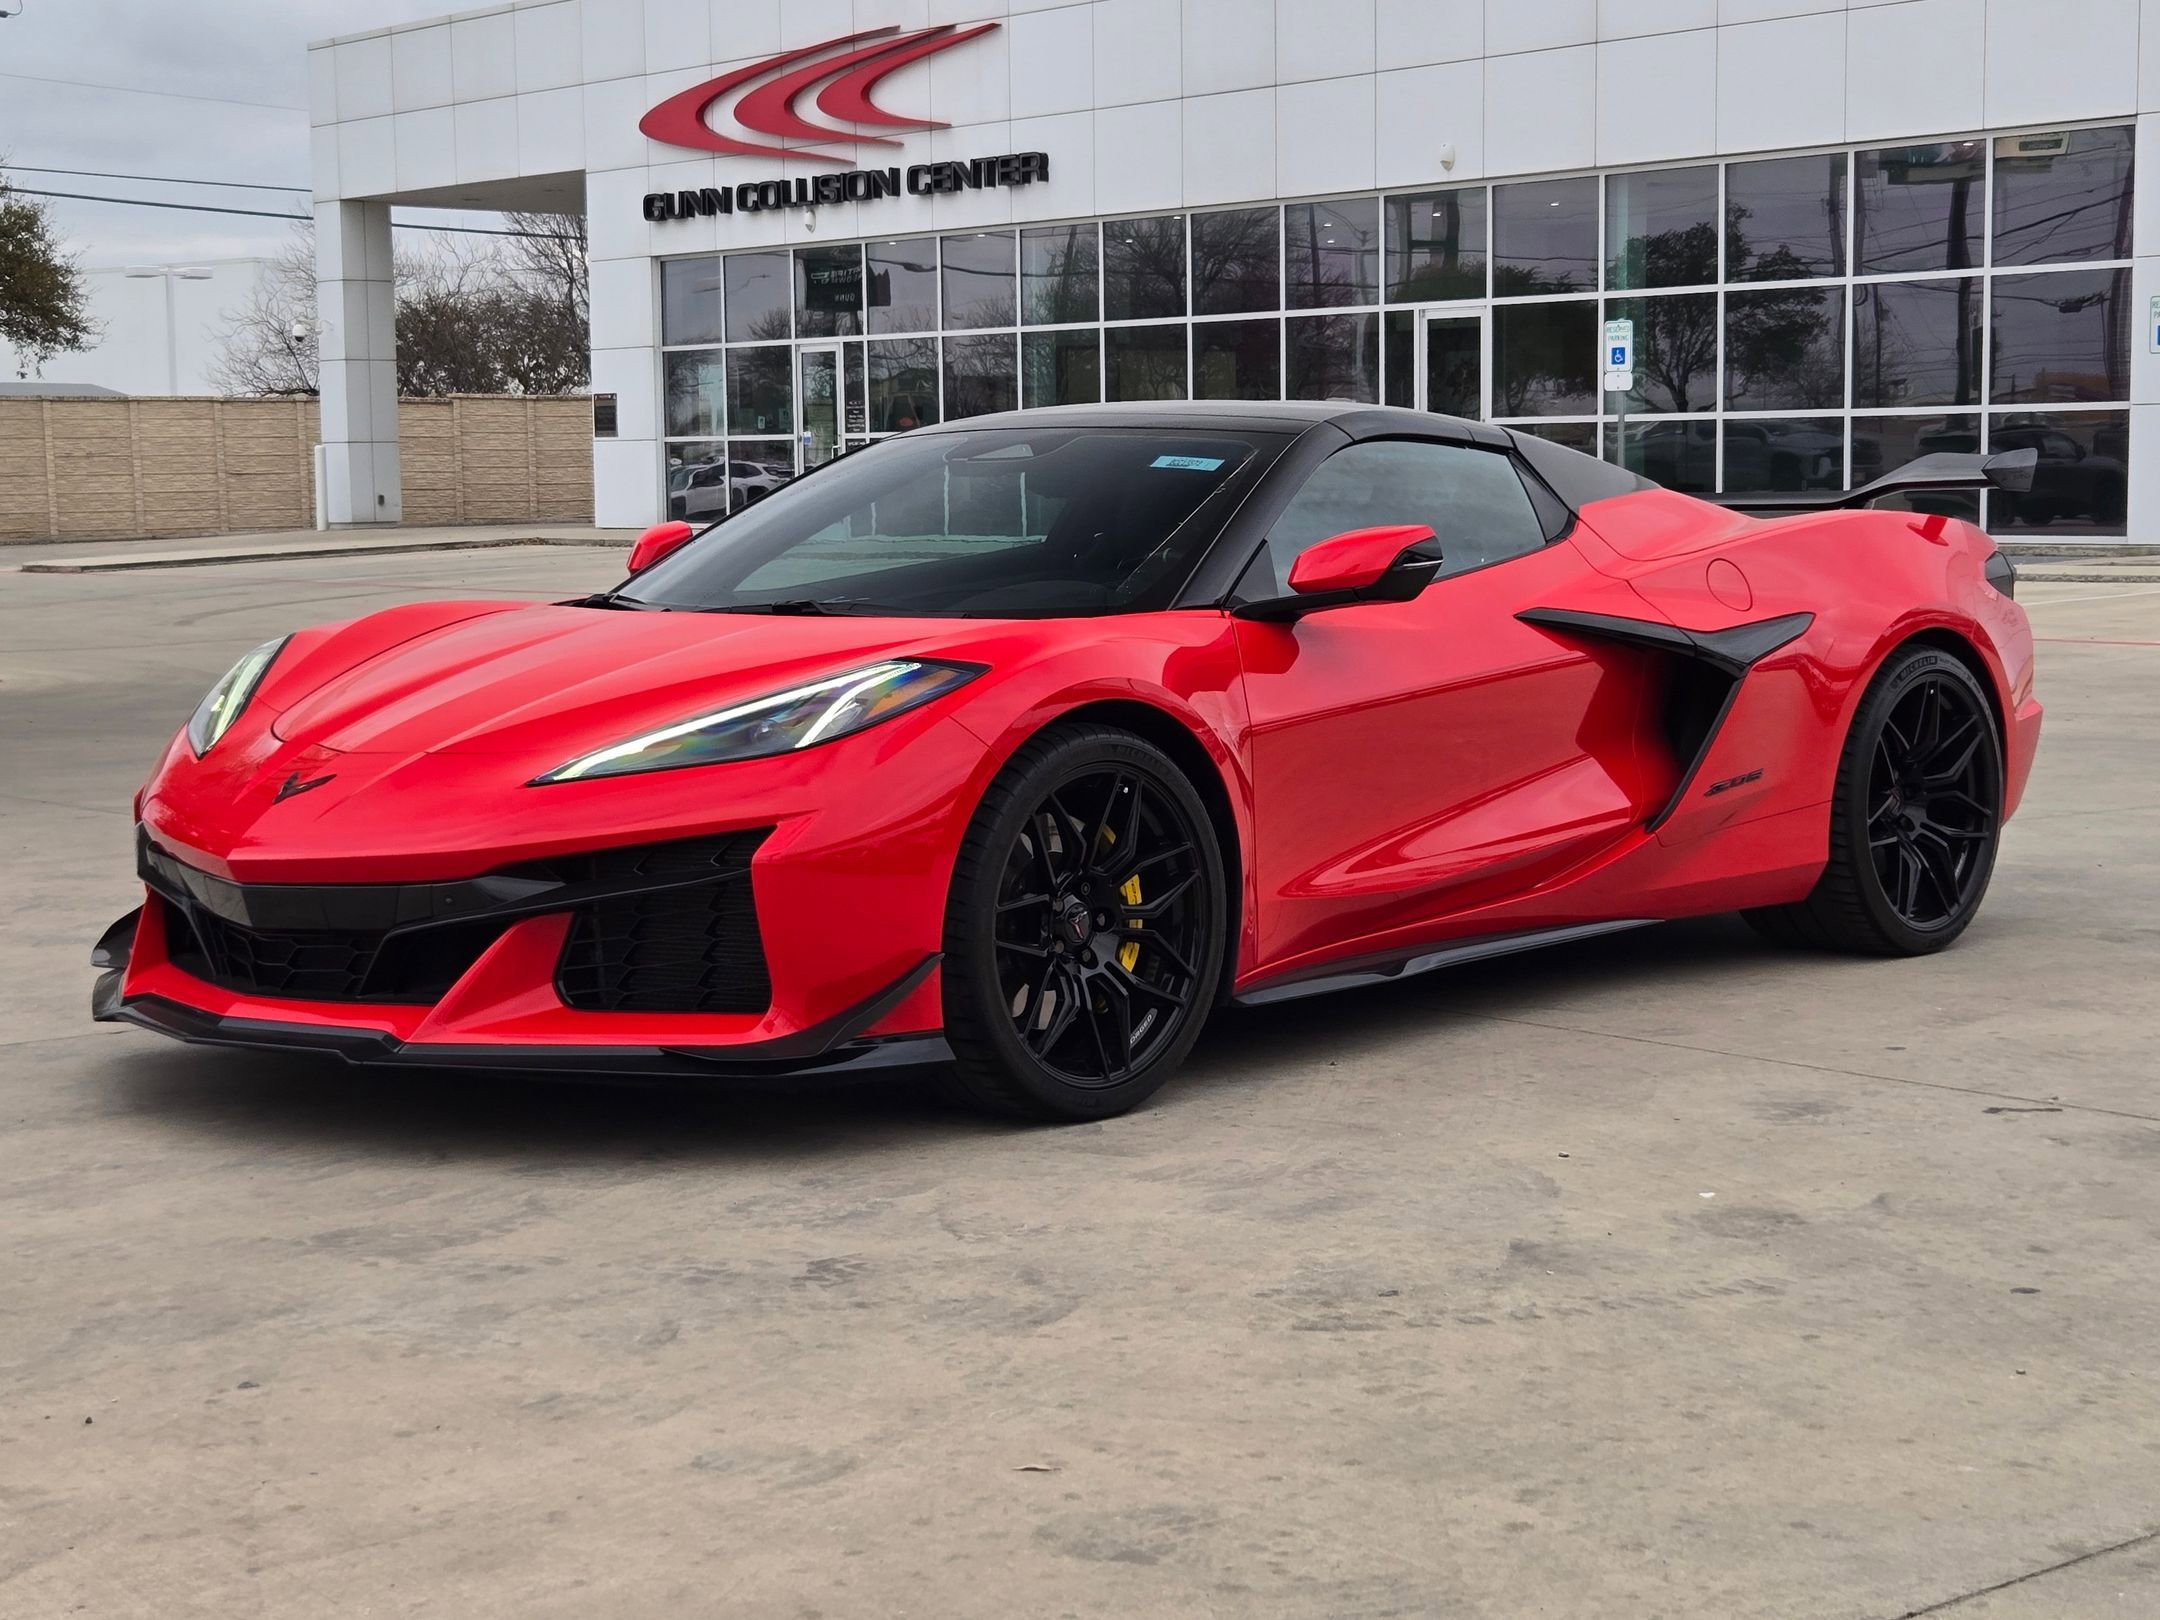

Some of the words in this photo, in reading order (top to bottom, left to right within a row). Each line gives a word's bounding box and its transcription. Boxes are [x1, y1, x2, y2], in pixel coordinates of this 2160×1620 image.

[643, 186, 733, 221] GUNN
[736, 167, 900, 211] COLLISION
[907, 152, 1049, 195] CENTER
[1900, 656, 1937, 679] MICHELIN
